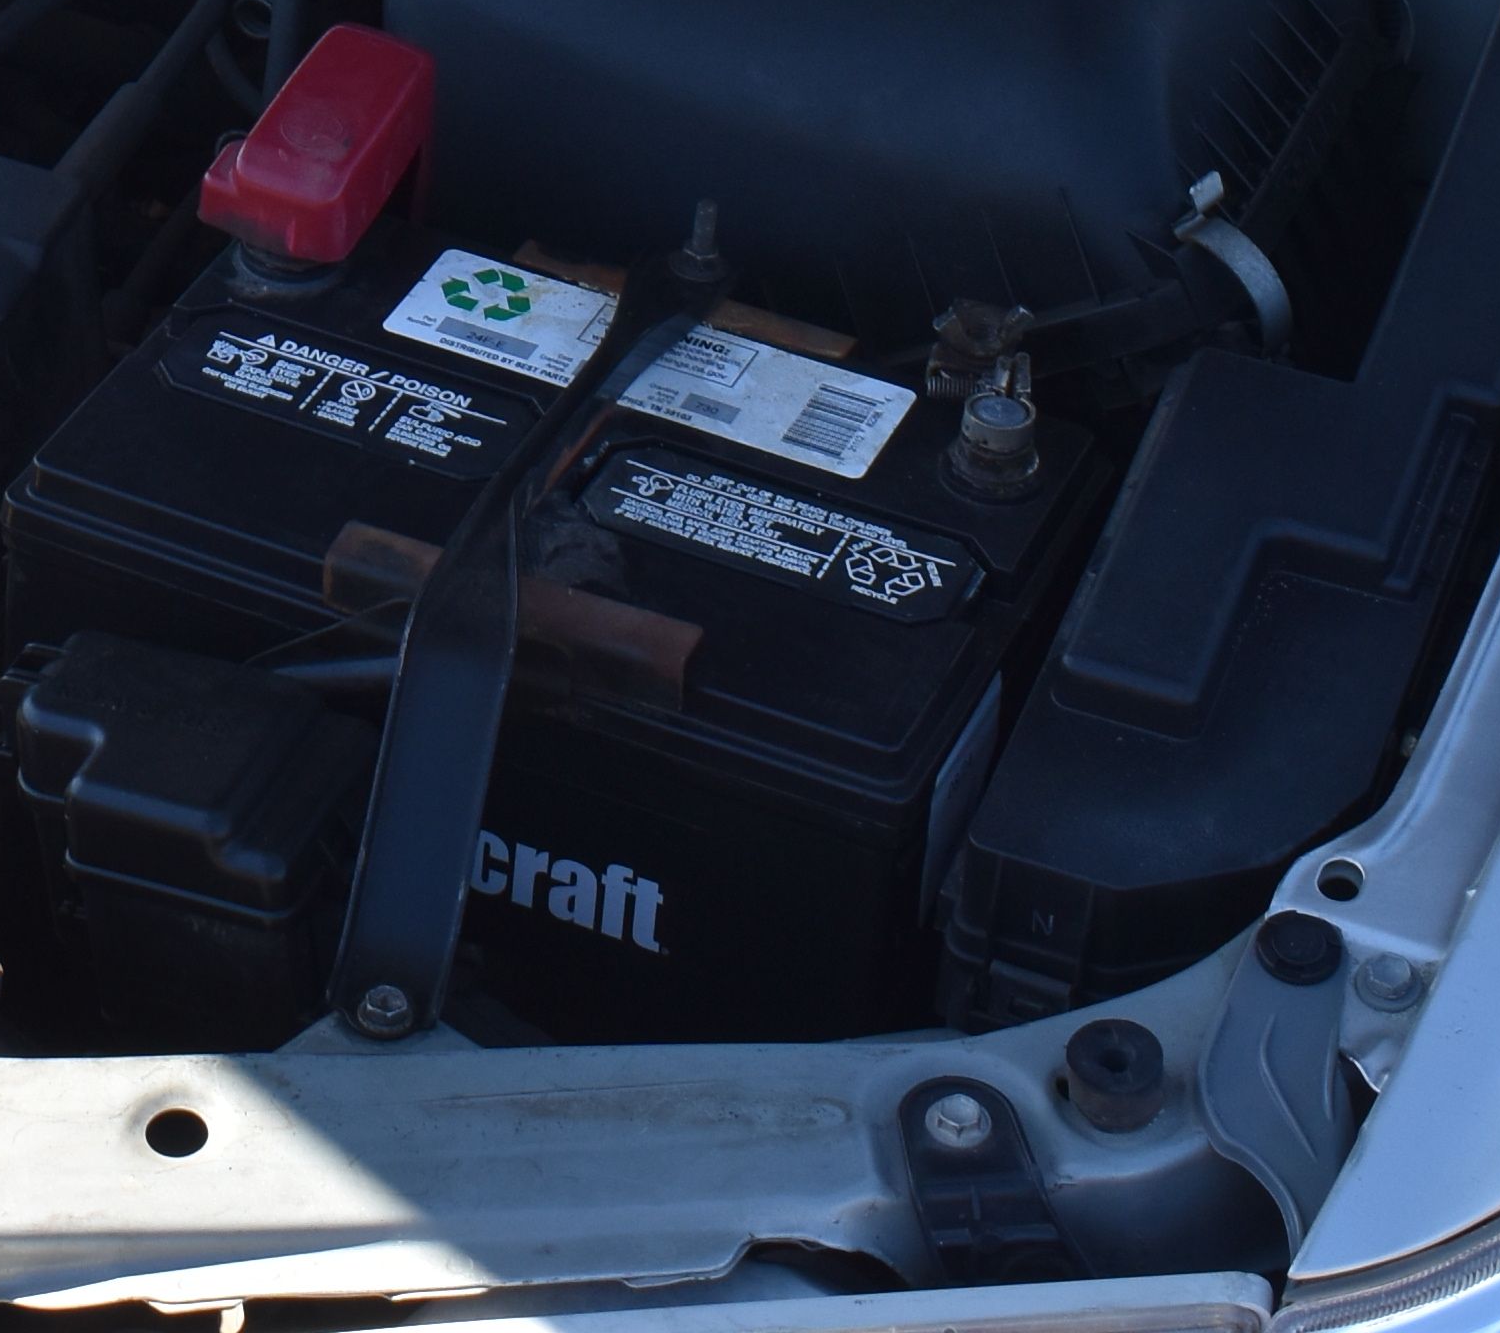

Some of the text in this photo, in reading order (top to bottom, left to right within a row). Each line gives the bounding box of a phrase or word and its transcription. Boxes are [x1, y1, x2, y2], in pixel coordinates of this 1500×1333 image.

[279, 341, 370, 377] DANGER
[388, 374, 473, 408] POISON
[439, 337, 571, 385] DISTRIBUTED BY BEST PARTS
[399, 415, 482, 447] SULFURIC ACID
[686, 473, 701, 483] DO
[703, 479, 723, 490] NOT
[736, 482, 758, 493] OUT
[759, 489, 774, 498] OF
[665, 498, 782, 539] MEDICAL HELP FAST
[672, 491, 702, 507] WITH
[748, 515, 775, 528] GET
[675, 483, 715, 501] FLUSH
[747, 507, 825, 536] IMMEDIATELY
[736, 534, 782, 552] STARTING
[781, 548, 820, 564] FOLLOW
[850, 584, 898, 605] RECYCLE
[1031, 909, 1055, 936] N
